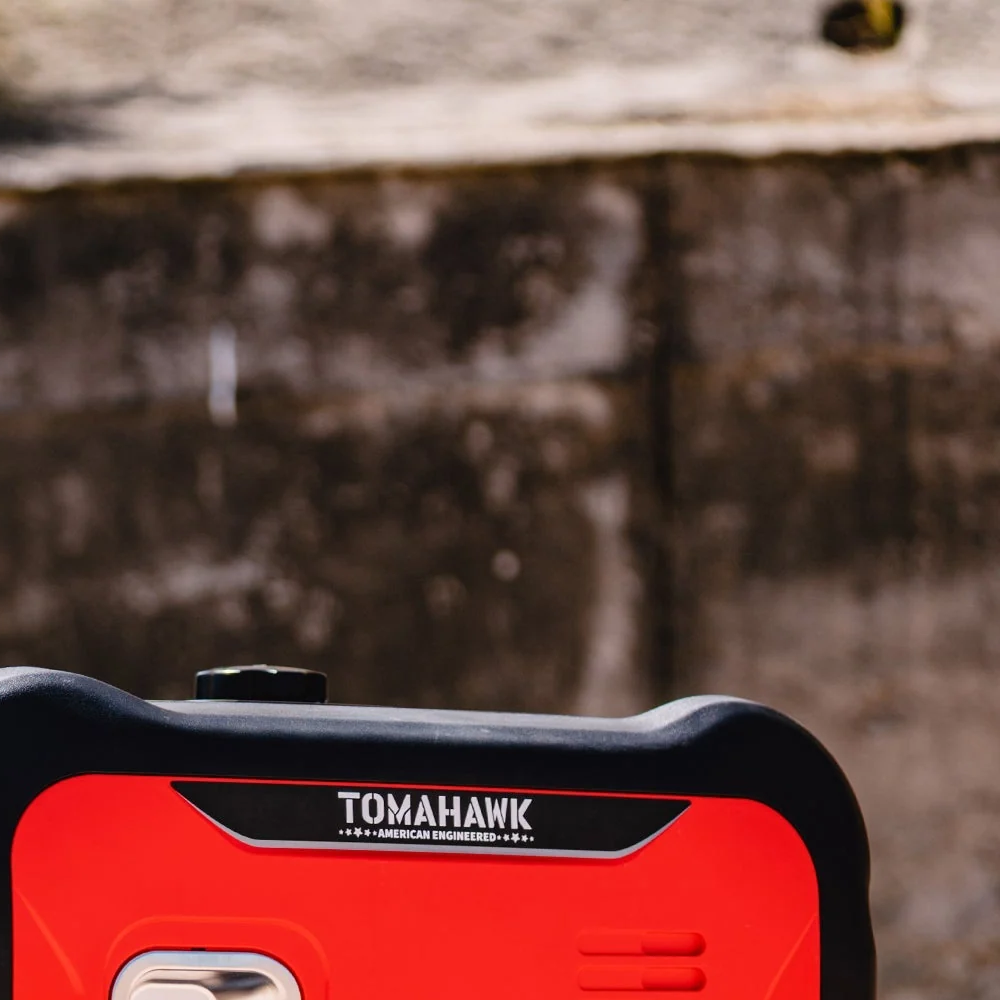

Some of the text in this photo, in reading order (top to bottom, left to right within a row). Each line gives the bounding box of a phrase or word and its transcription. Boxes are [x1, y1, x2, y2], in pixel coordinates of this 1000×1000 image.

[337, 791, 532, 830] TOMAHAWK
[377, 828, 497, 842] AMERICAN ENGINEERED
